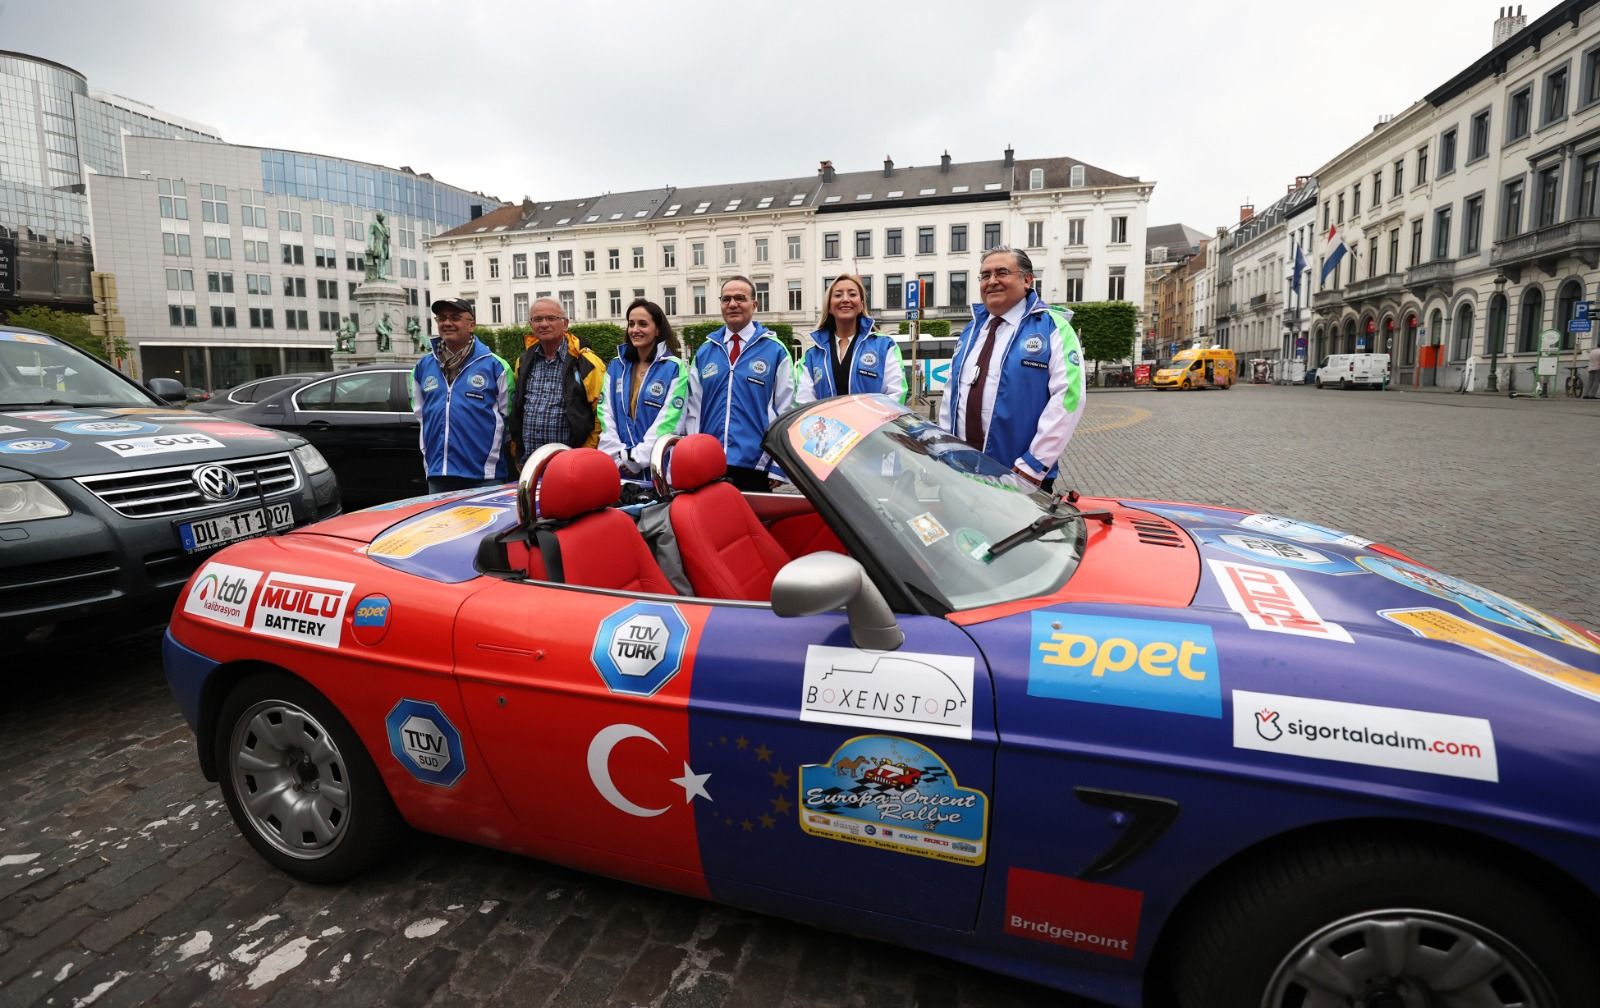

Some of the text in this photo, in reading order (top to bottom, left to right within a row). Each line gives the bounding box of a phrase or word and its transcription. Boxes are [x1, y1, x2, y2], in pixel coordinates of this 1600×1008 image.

[908, 282, 917, 299] P
[1575, 304, 1588, 318] P
[193, 520, 220, 544] DU
[230, 513, 251, 535] TT
[217, 575, 248, 605] tdb
[260, 579, 345, 619] MUTLU
[203, 599, 241, 617] kalibrasyon
[356, 606, 387, 617] opet
[264, 614, 326, 637] BATTERY
[630, 625, 660, 641] TÜV
[617, 641, 659, 661] TÜRK
[1038, 632, 1207, 681] opet
[806, 685, 957, 718] BOXENSTOP
[404, 728, 443, 753] TÜV
[877, 803, 962, 823] Rallye
